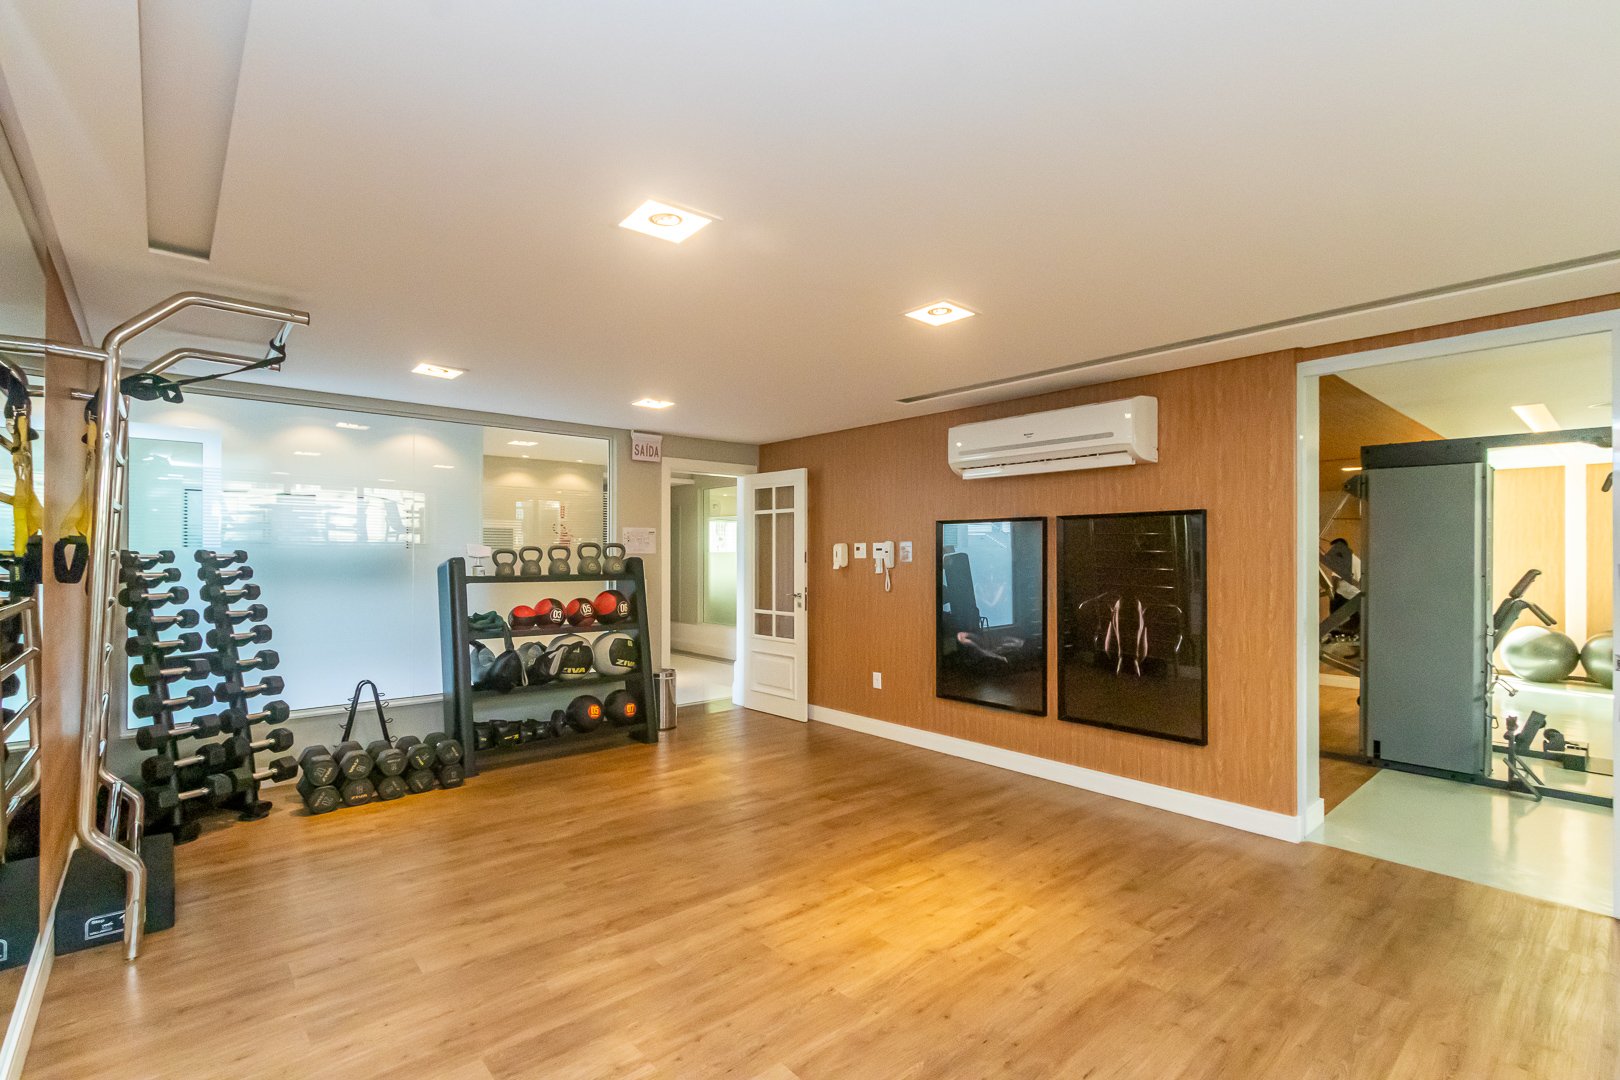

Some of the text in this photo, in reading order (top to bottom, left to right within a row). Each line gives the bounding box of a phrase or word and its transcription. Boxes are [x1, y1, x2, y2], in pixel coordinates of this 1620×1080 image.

[634, 443, 659, 458] SAÍDA
[582, 604, 592, 613] 05
[552, 609, 562, 619] 03
